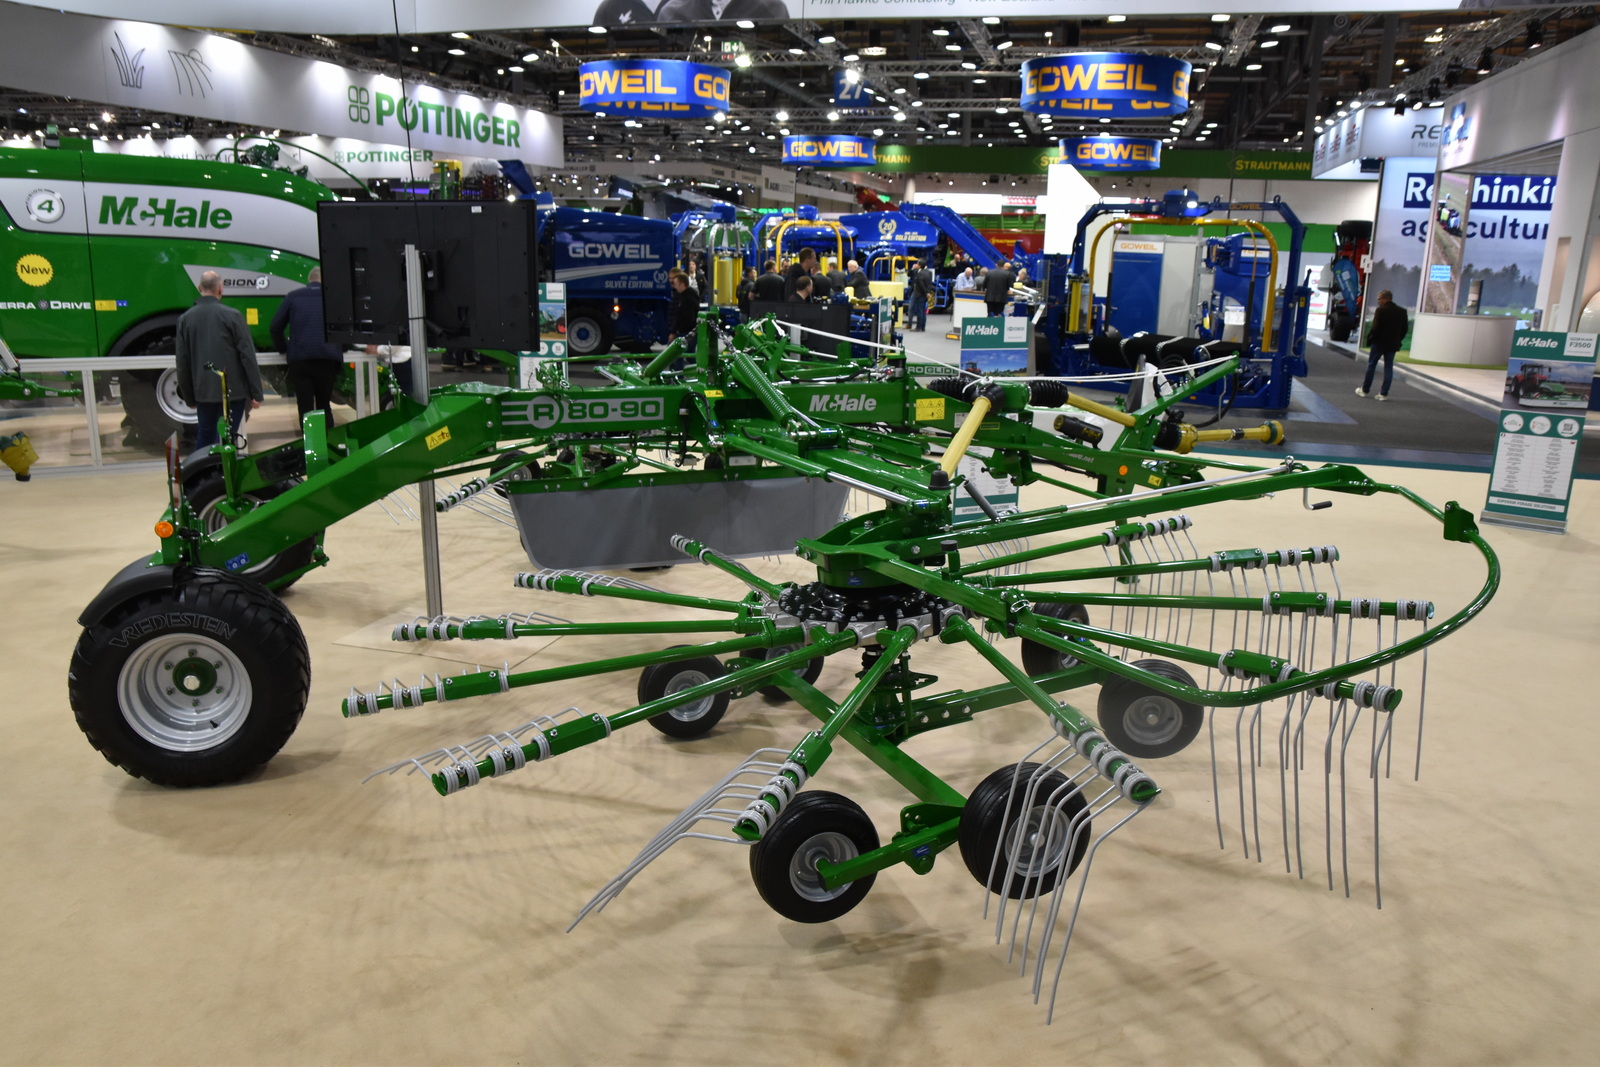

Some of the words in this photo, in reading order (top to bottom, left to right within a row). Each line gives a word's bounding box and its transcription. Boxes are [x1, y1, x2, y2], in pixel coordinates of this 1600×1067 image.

[1235, 160, 1311, 171] STRAUTMANN
[37, 199, 55, 214] 4
[99, 195, 233, 229] McHale
[20, 263, 51, 276] New
[568, 400, 661, 420] 80-90
[809, 394, 877, 412] McHale
[109, 611, 237, 648] VREDESTEIN
